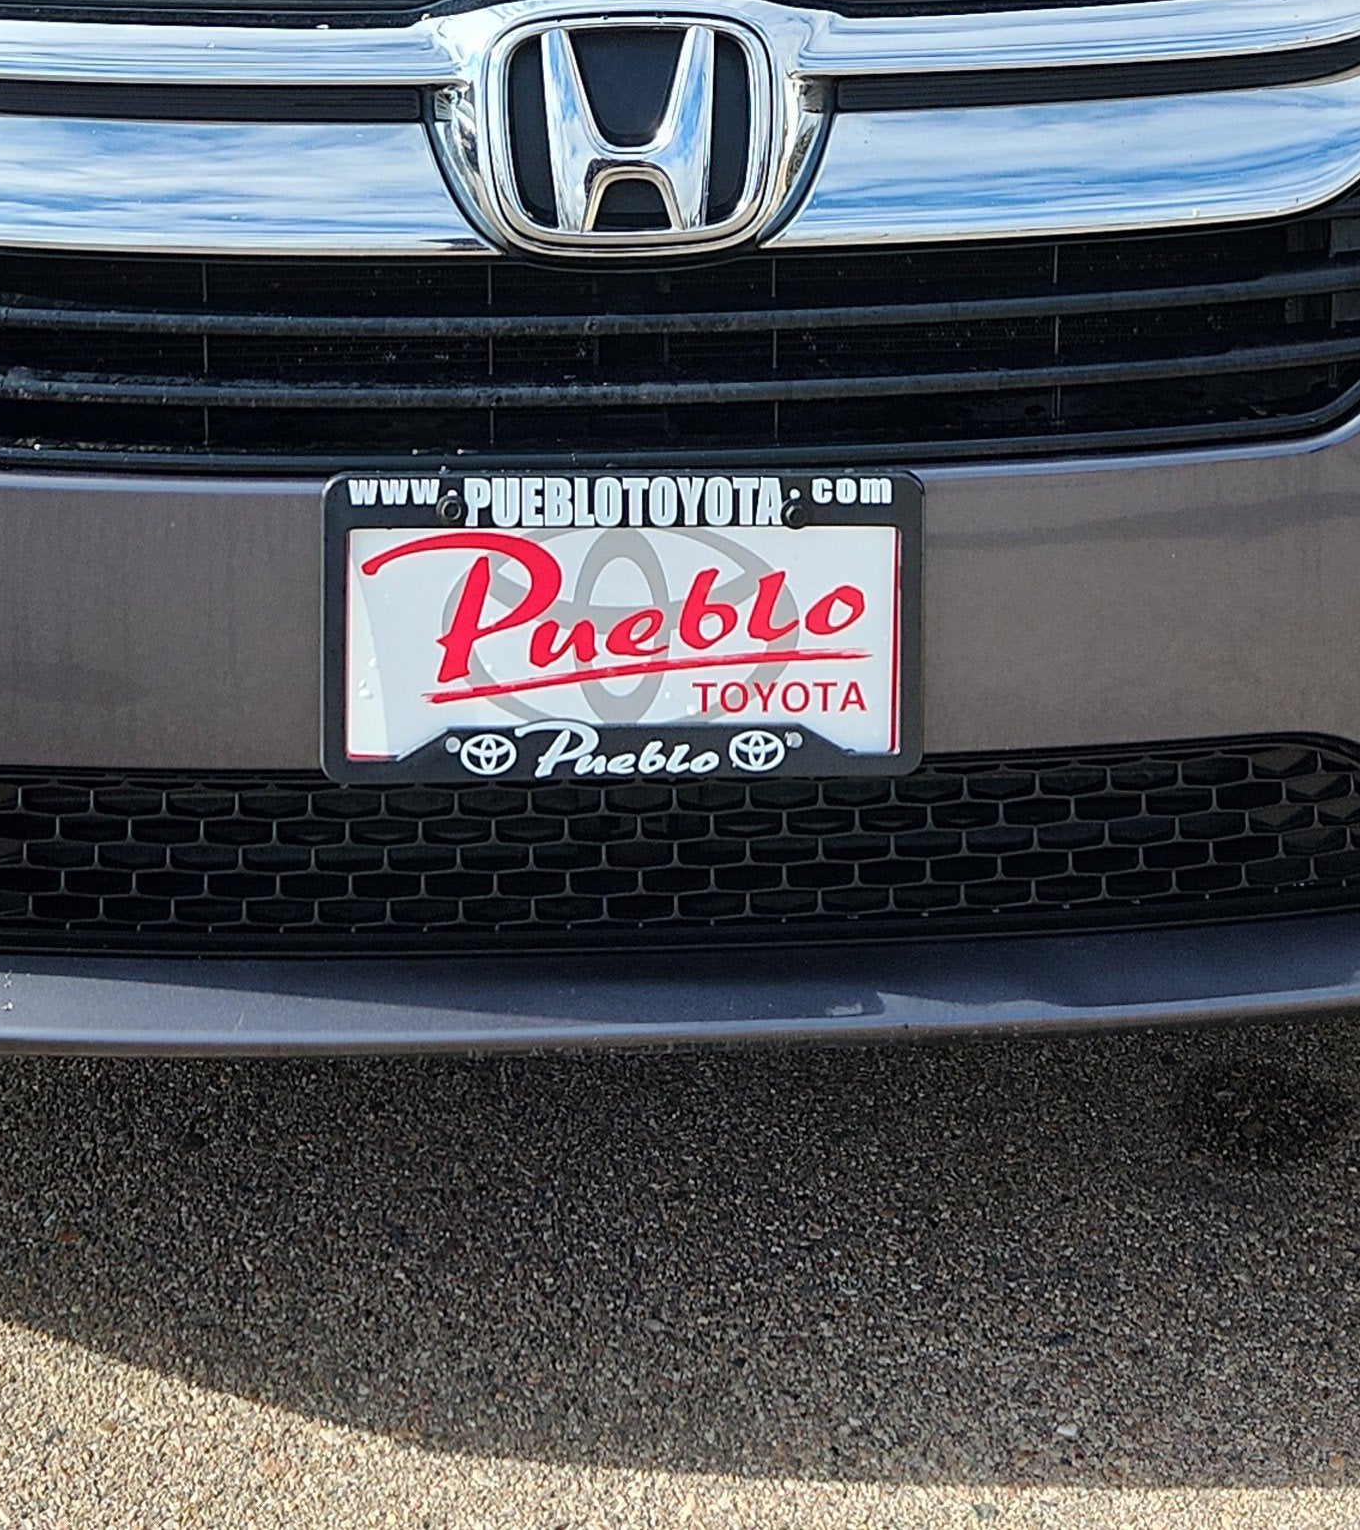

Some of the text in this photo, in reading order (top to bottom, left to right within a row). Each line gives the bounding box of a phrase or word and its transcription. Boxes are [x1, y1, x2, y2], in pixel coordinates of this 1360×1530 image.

[361, 532, 867, 683] Pueblo
[693, 683, 868, 713] TOYOTA
[513, 722, 720, 776] Pueblo
